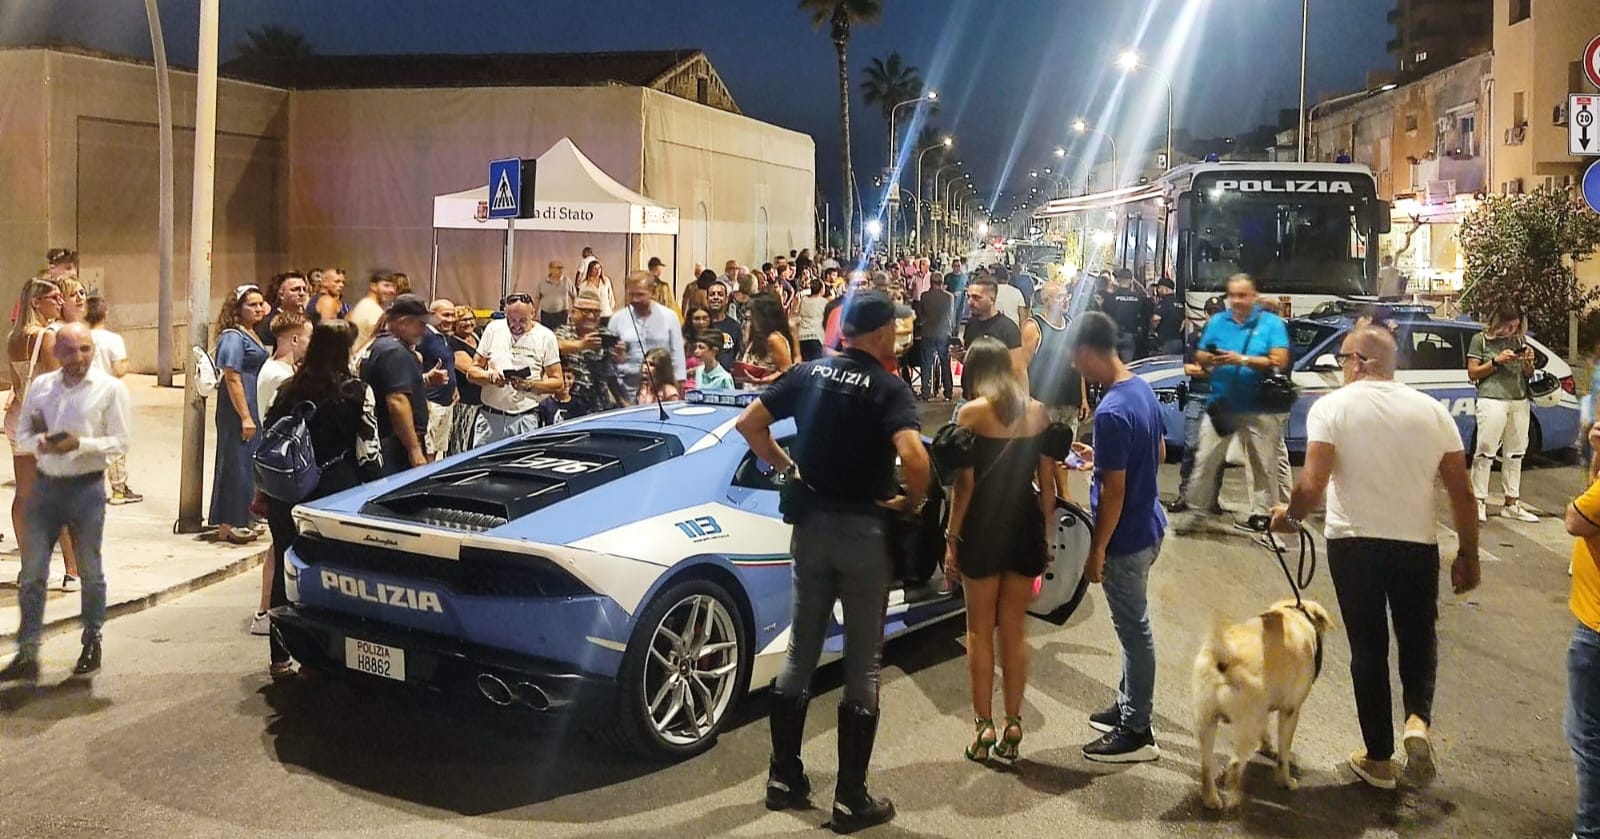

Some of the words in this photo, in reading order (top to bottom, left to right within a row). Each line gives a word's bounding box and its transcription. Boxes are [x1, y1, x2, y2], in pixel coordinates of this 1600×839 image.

[1579, 114, 1590, 123] 20
[1215, 180, 1353, 194] POLIZIA
[543, 201, 556, 219] di
[560, 202, 594, 221] Stato
[811, 364, 871, 389] POLIZIA
[674, 515, 722, 538] 113
[320, 570, 443, 613] POLIZIA
[357, 641, 390, 658] POLIZIA
[358, 654, 391, 676] H8862
